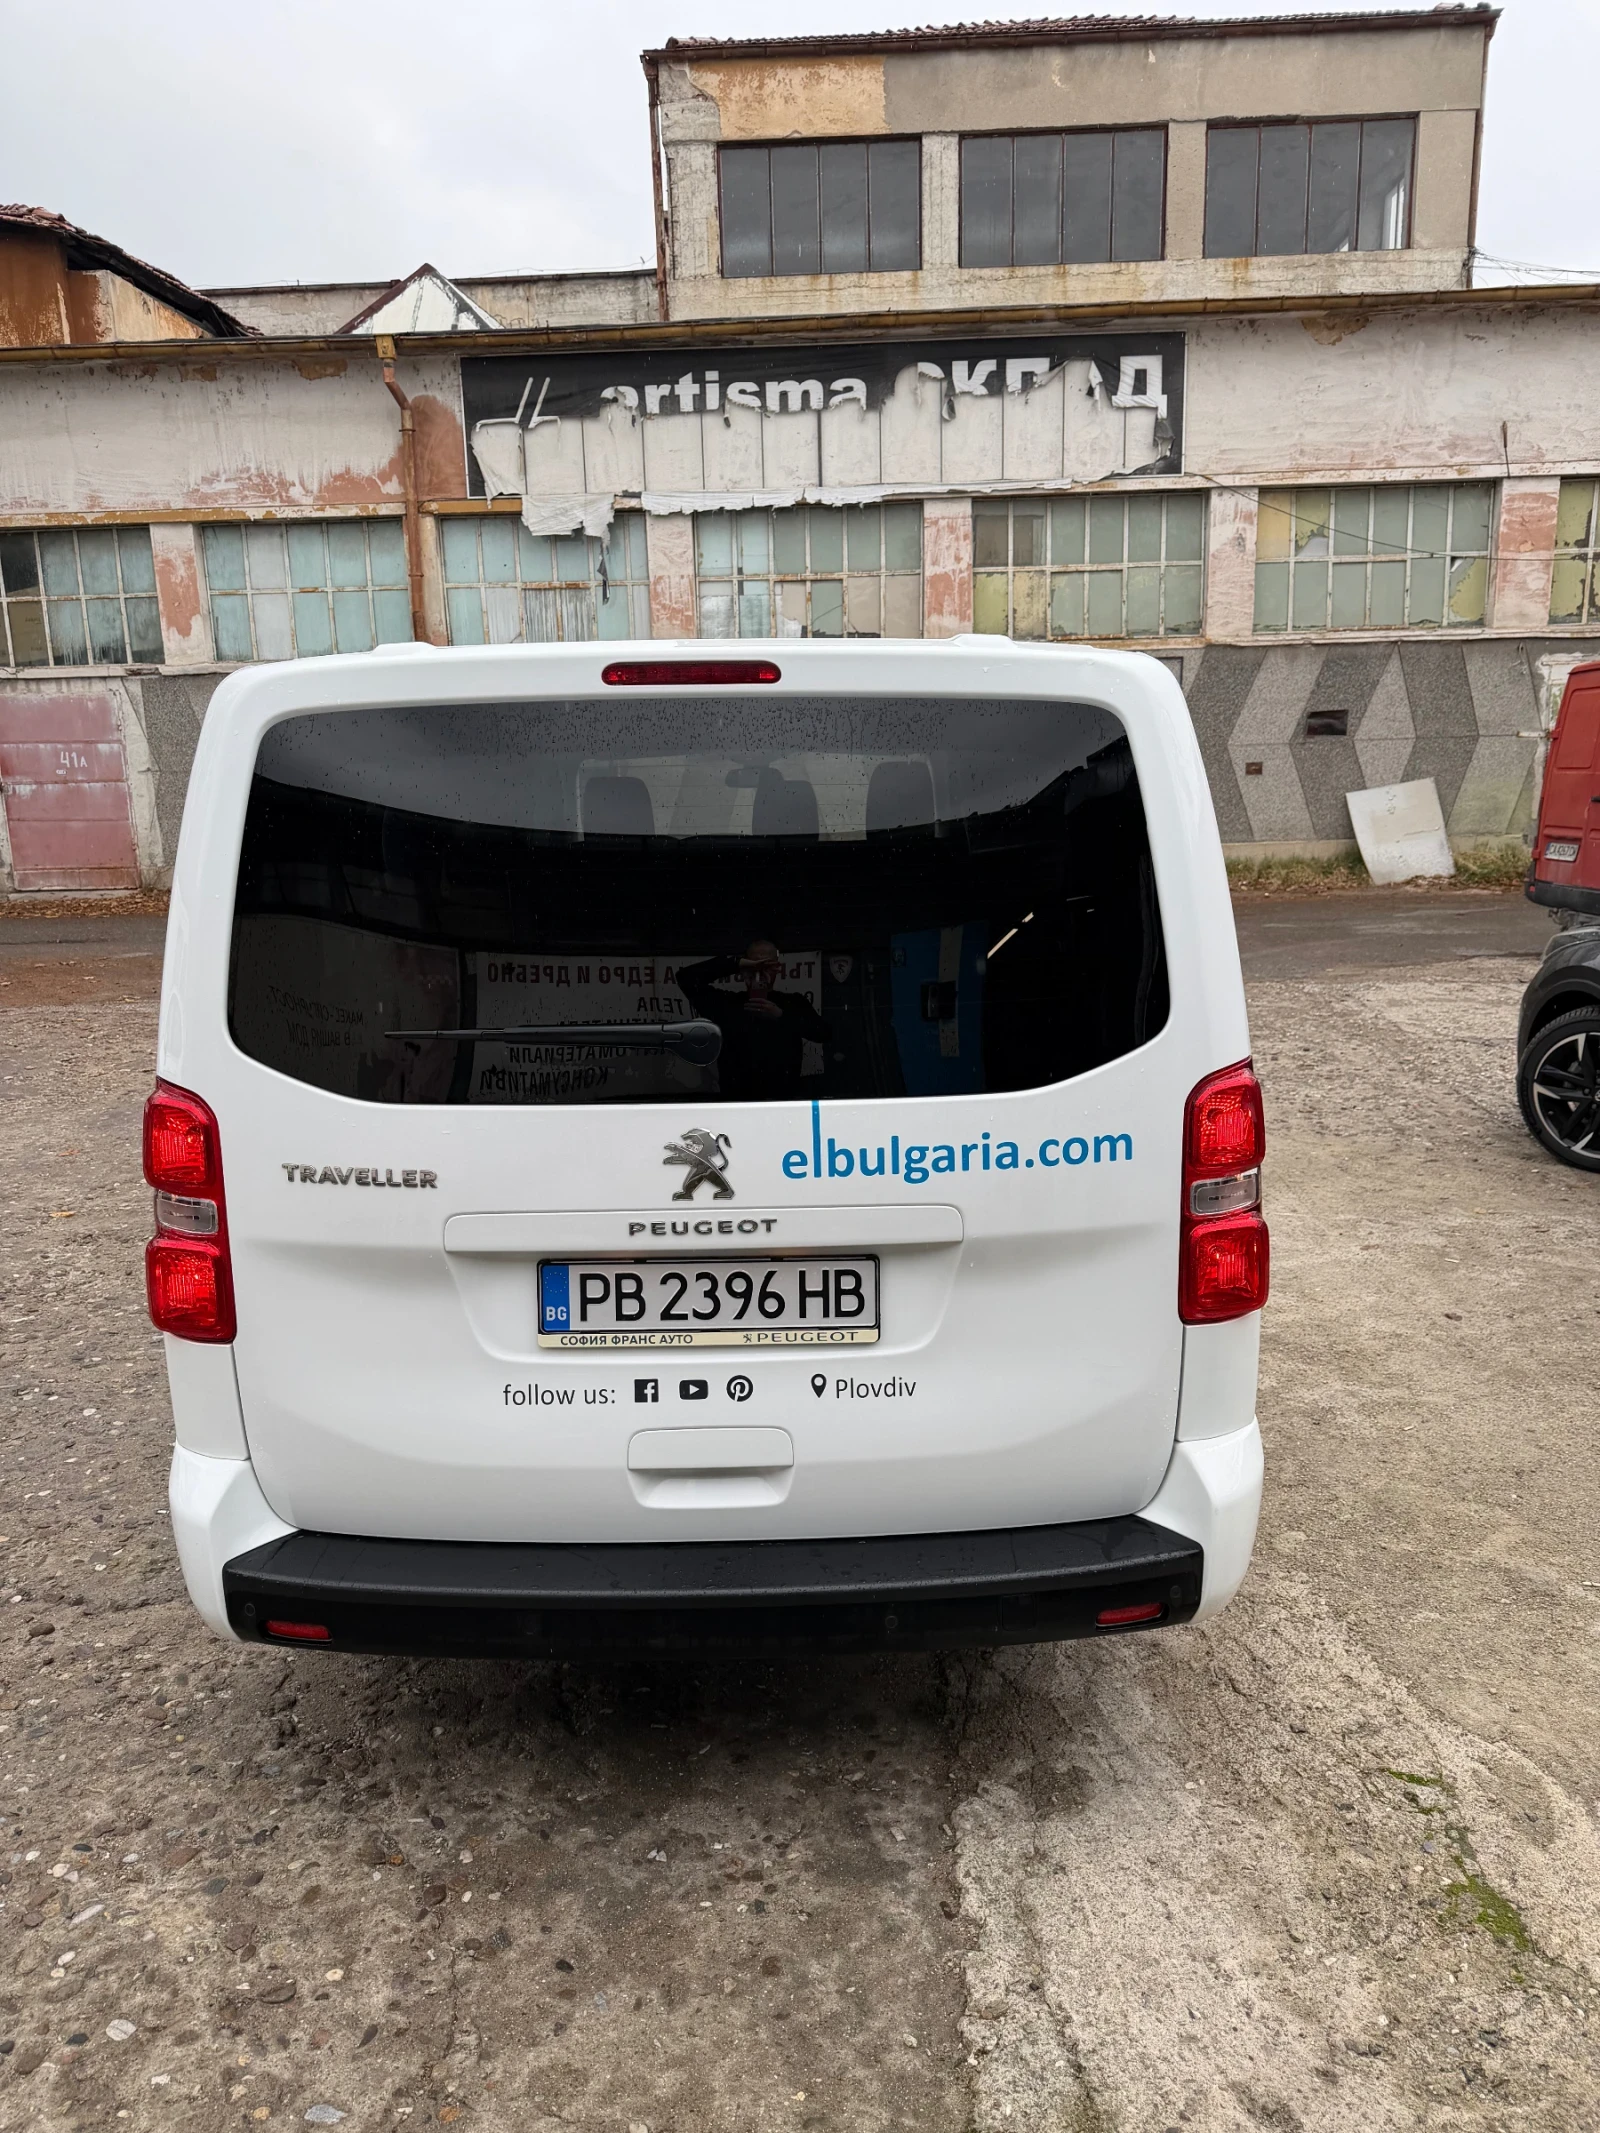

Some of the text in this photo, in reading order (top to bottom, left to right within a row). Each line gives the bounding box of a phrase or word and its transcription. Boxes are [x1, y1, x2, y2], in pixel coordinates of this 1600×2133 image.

[781, 1101, 1134, 1185] elbulgaria.com
[281, 1162, 438, 1189] TRAVELLER
[627, 1218, 778, 1237] PEUGEOT
[545, 1268, 866, 1323] BG PB 2396 HB
[559, 1333, 694, 1347] СОФИЯ ФРАНС АУТО
[756, 1331, 860, 1343] PEUGEOT
[502, 1383, 617, 1406] follow us:
[835, 1376, 917, 1400] Plovdiv
